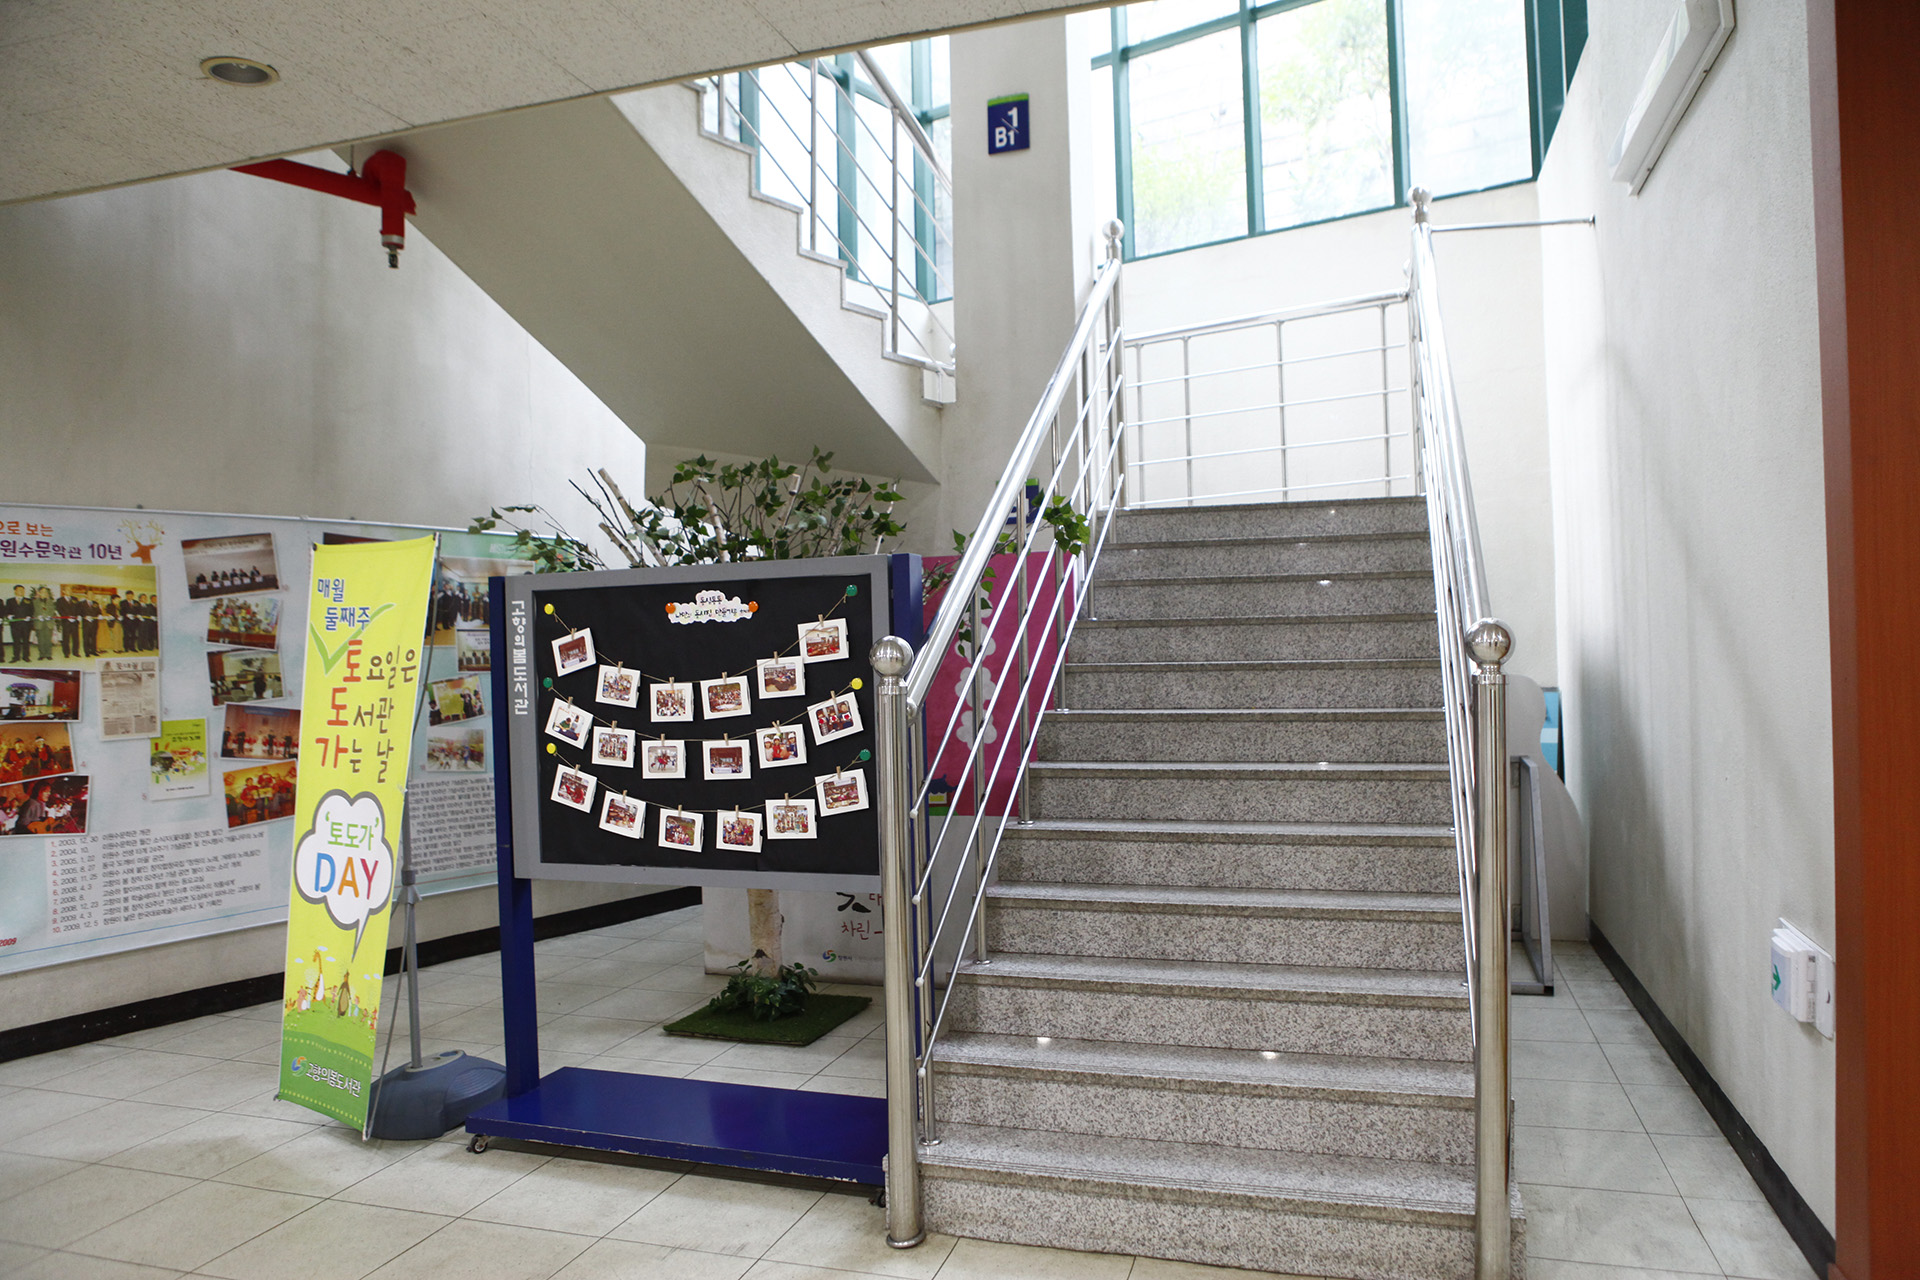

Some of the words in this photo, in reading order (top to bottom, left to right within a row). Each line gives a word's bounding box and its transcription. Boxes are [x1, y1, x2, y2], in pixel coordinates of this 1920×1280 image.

[1007, 106, 1018, 127] 1
[995, 126, 1015, 148] B1
[26, 522, 54, 537] 보는
[0, 540, 82, 559] 원수문학관
[88, 543, 122, 560] 10년
[317, 578, 345, 602] 매월
[324, 607, 370, 631] 둘째주
[342, 639, 417, 690] 토요일은
[326, 686, 395, 734] 도서관
[315, 734, 363, 773] 가는
[376, 738, 394, 783] 날
[314, 852, 379, 900] DAY
[841, 920, 870, 940] 차린
